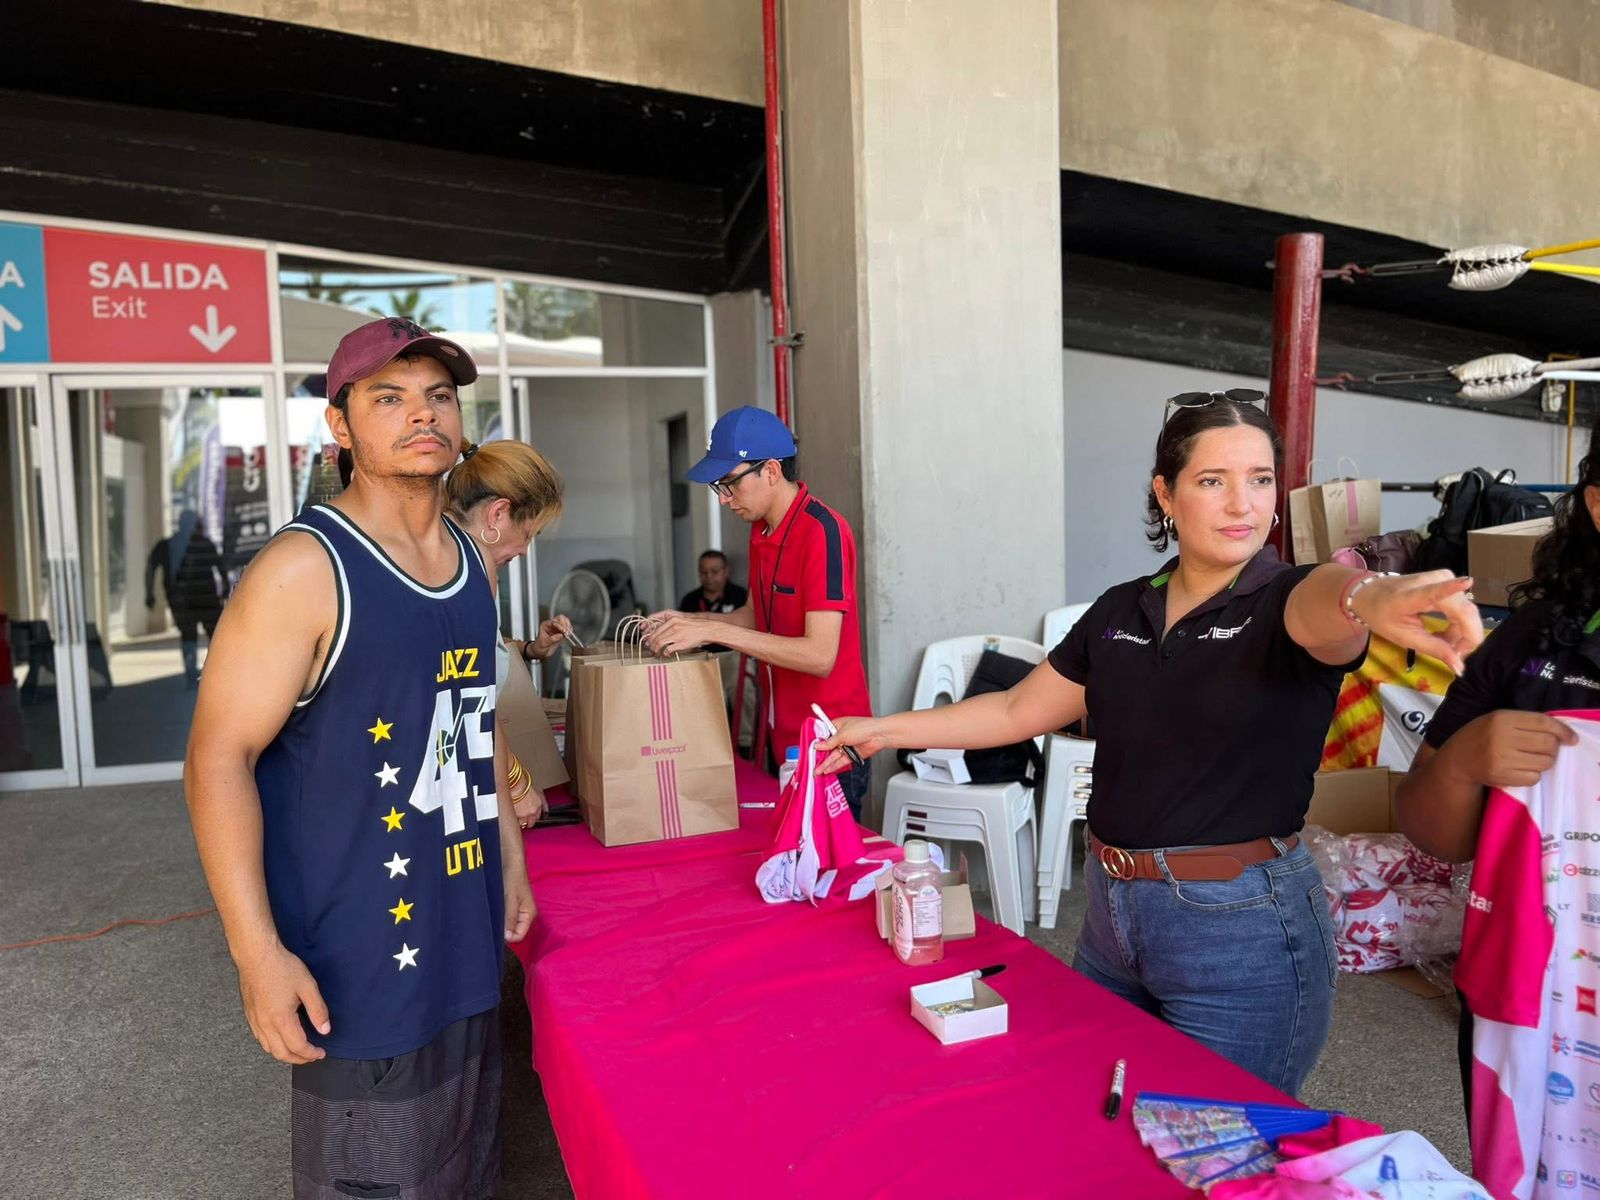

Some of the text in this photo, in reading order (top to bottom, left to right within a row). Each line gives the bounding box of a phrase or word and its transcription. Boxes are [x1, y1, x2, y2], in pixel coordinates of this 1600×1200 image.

[88, 261, 229, 290] SALIDA
[92, 296, 147, 319] Exit
[436, 648, 480, 683] JAZZ
[653, 744, 687, 756] Liverpool
